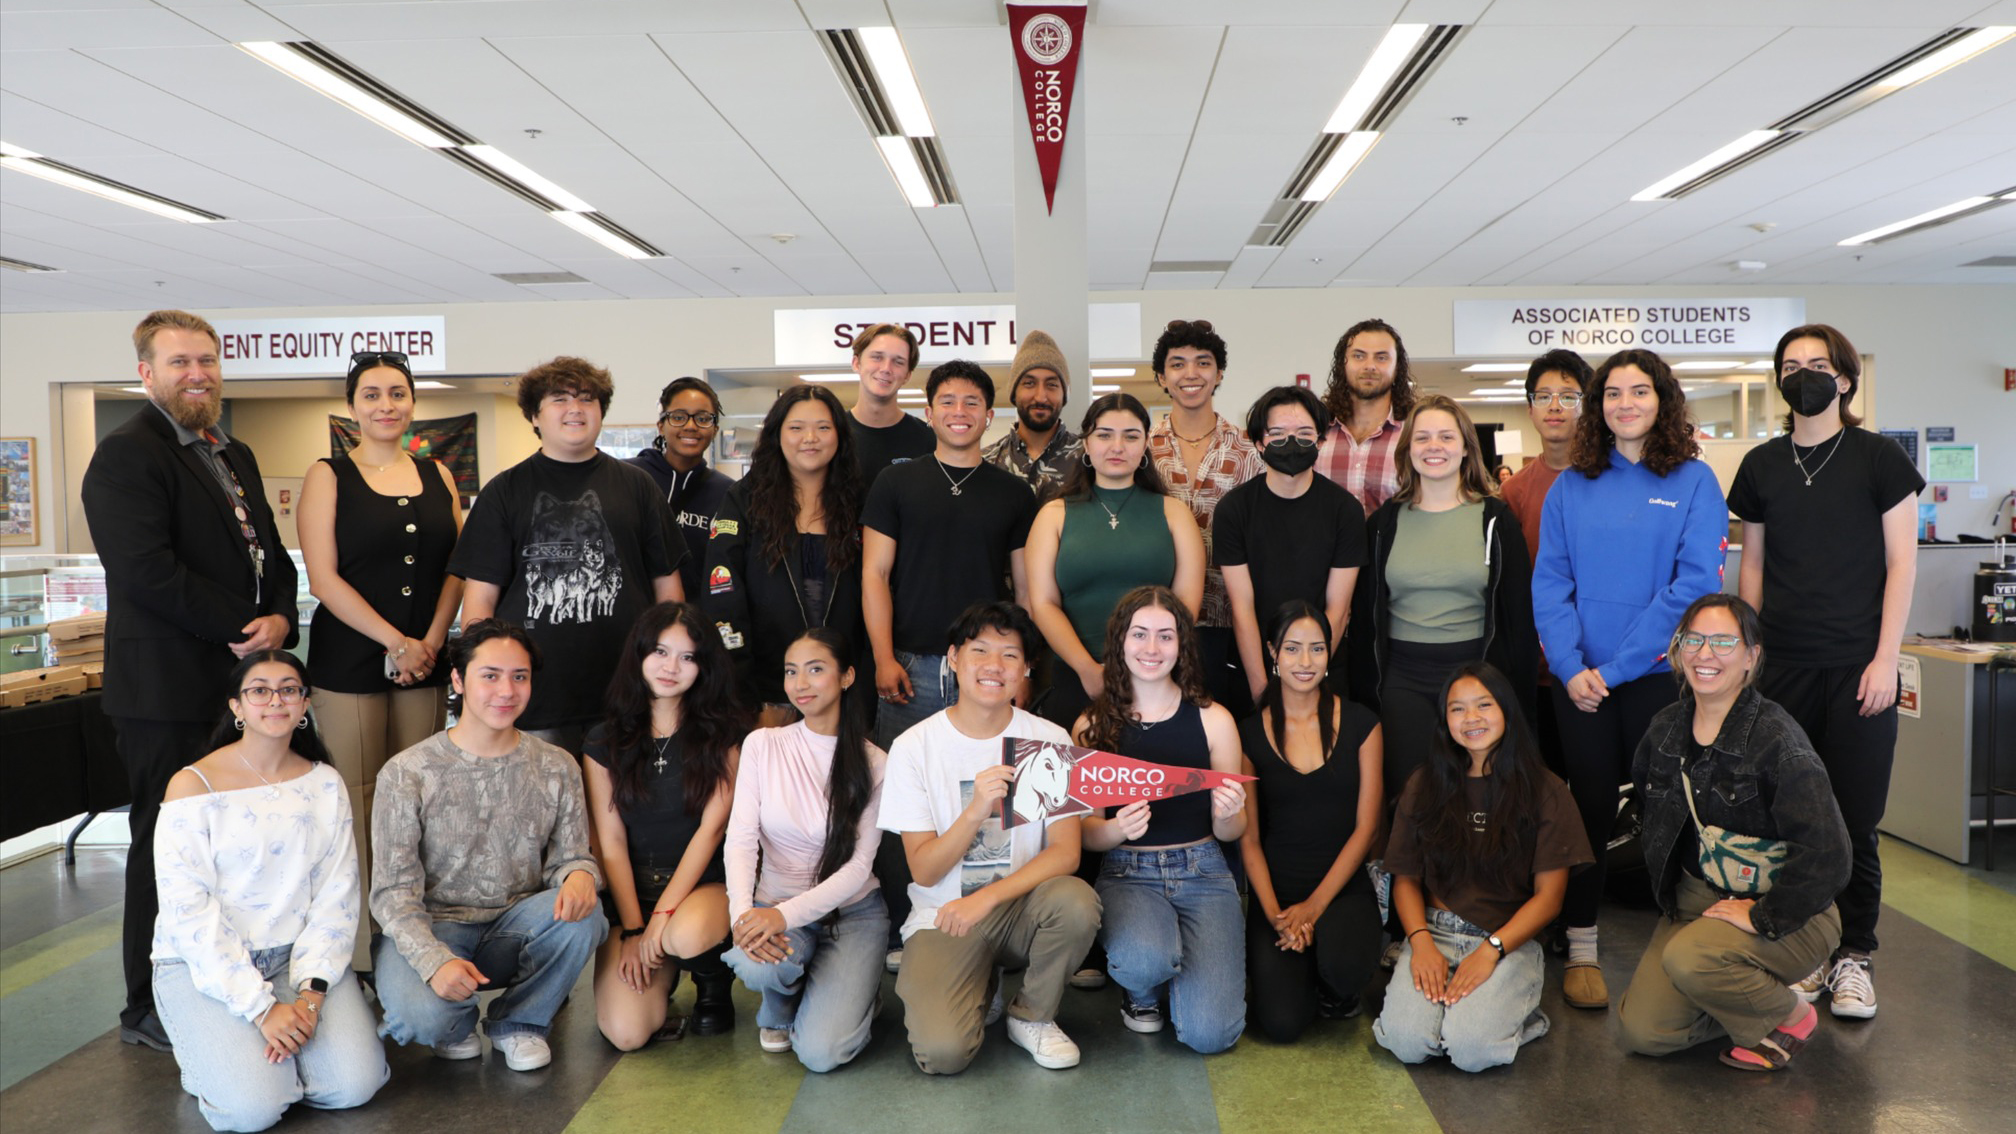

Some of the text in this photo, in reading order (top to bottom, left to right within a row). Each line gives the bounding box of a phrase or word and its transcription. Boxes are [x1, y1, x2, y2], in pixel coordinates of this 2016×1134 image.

[1035, 70, 1045, 142] COLLEGE
[1046, 70, 1062, 142] NORCO
[1512, 307, 1750, 323] ASSOCIATED STUDENTS
[218, 331, 433, 359] ENT EQUITY CENTER
[834, 321, 996, 348] SDENT
[1528, 329, 1735, 345] OF NORCO COLLEGE
[1080, 766, 1165, 786] NORCO
[1080, 785, 1163, 797] COLLEGE
